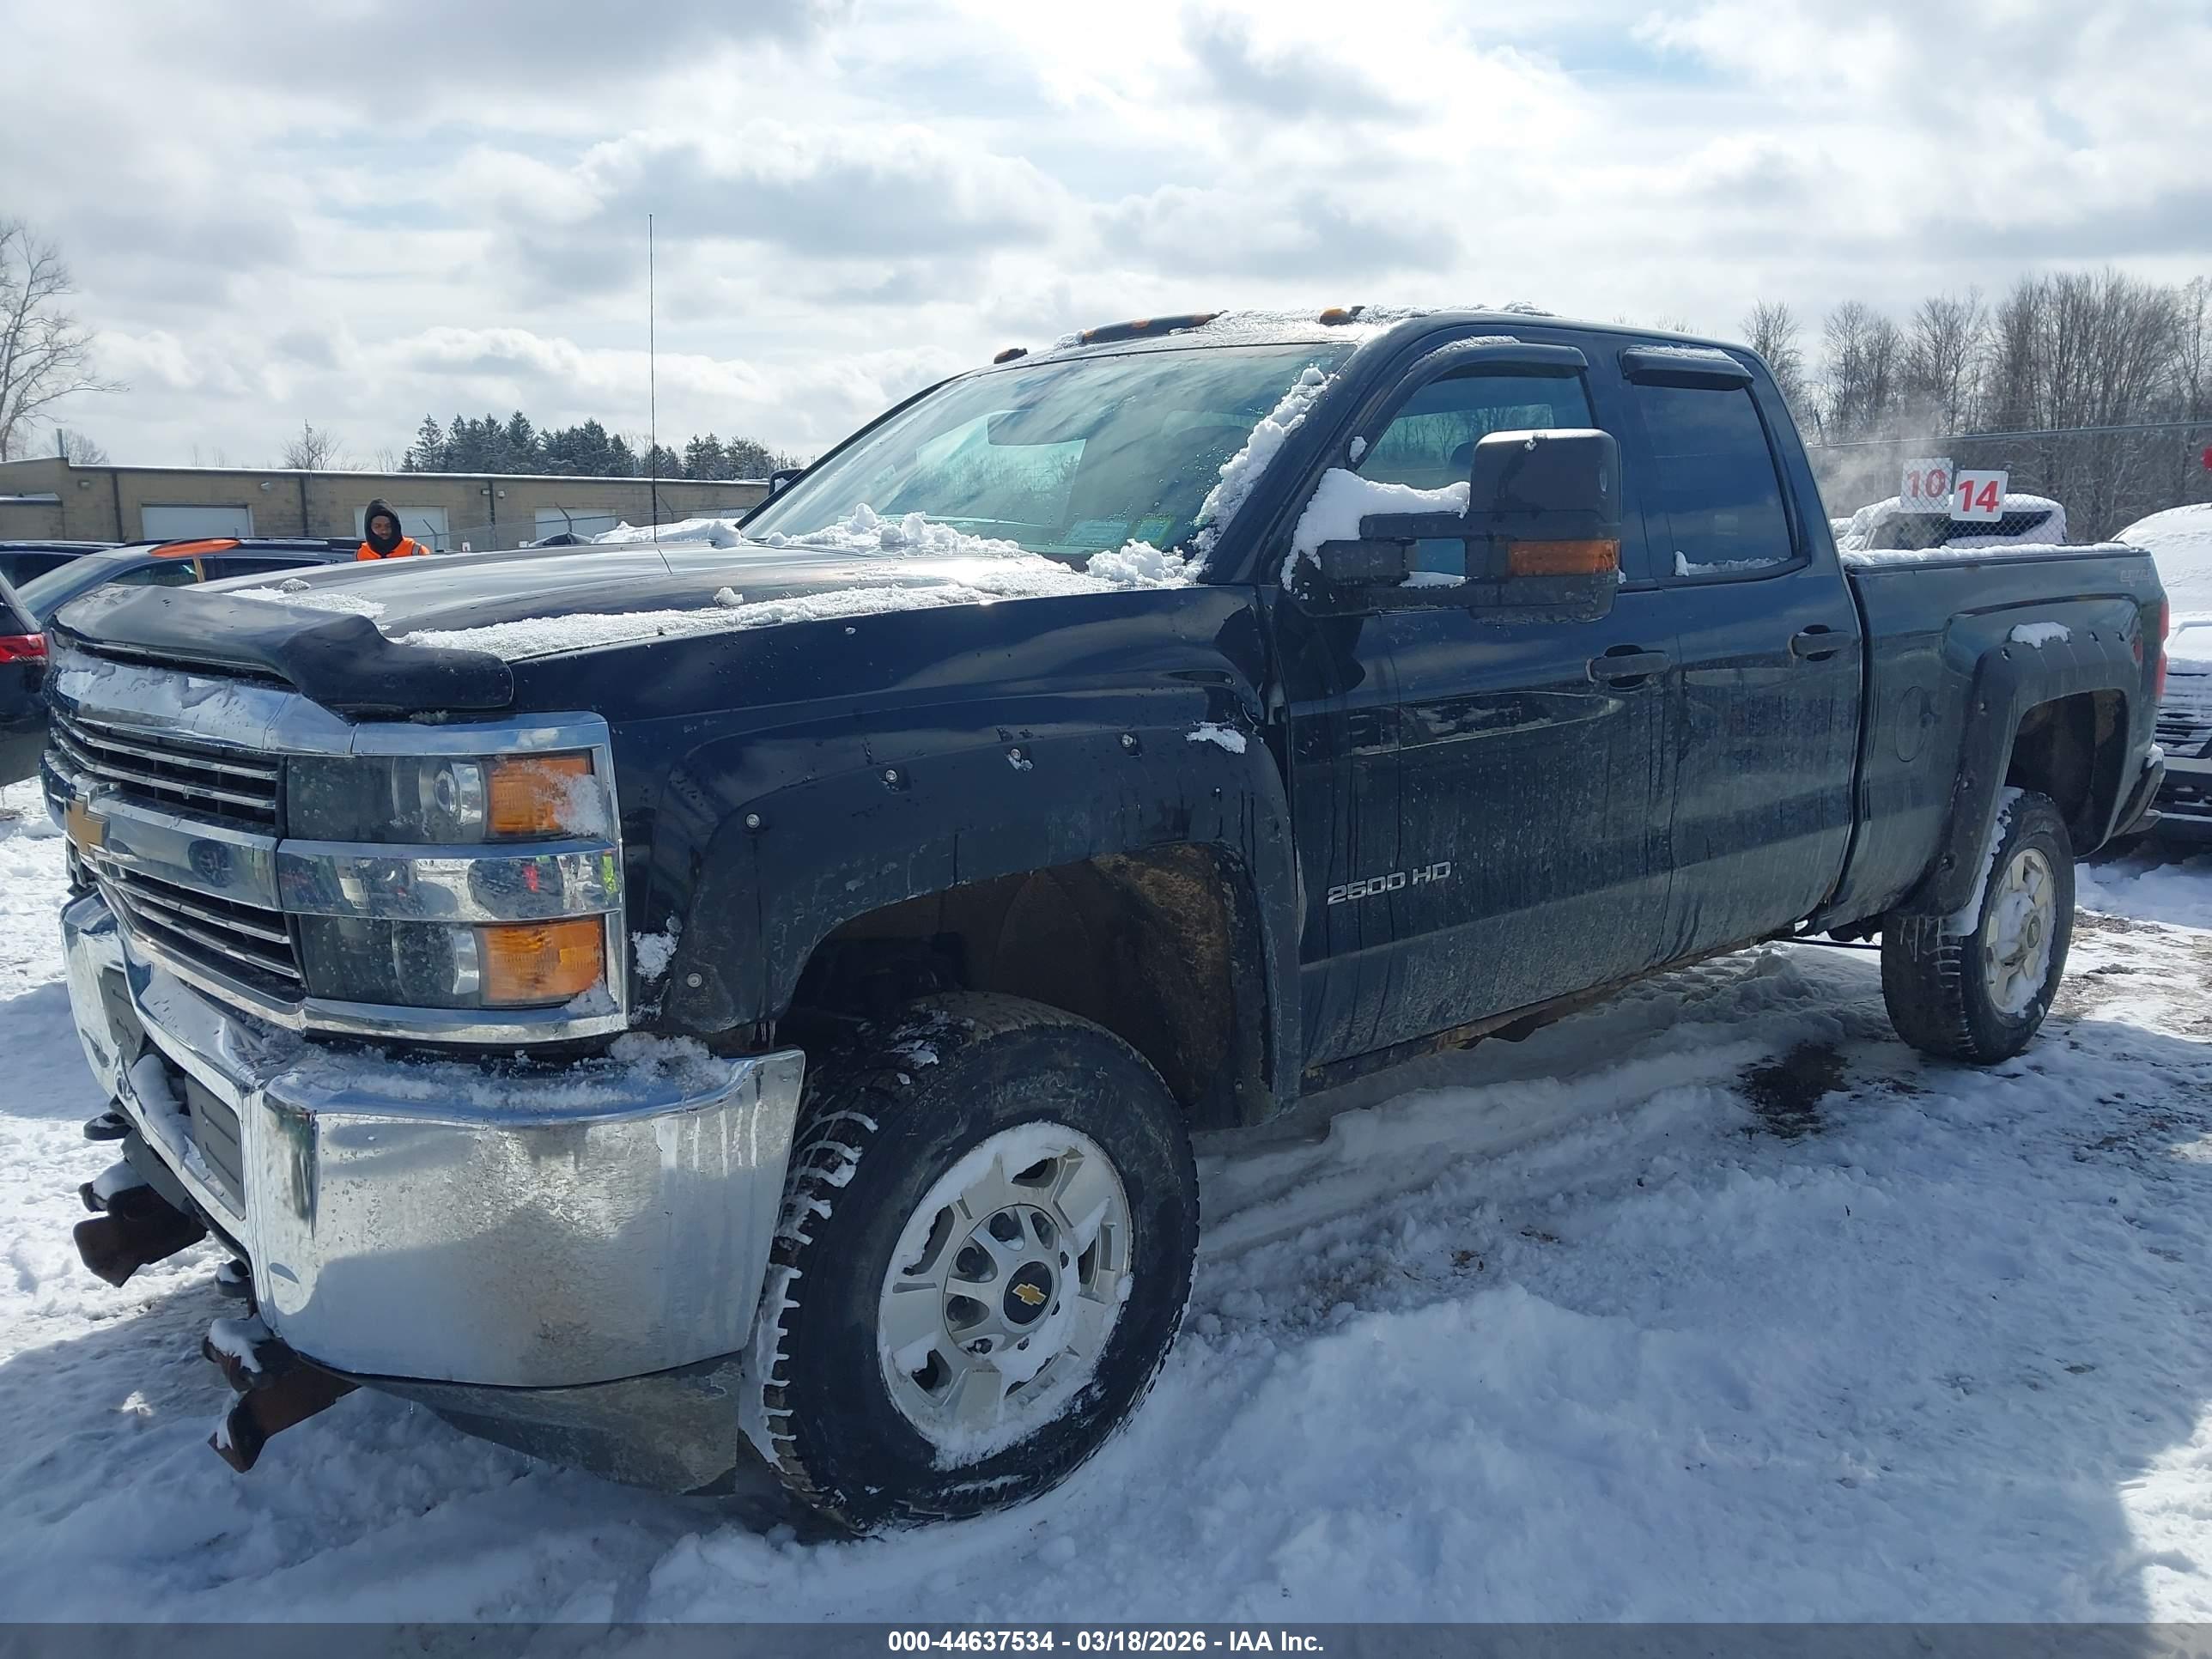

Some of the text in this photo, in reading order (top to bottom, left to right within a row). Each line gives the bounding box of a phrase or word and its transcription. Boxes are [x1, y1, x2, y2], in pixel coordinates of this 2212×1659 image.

[1907, 468, 1947, 499] 10
[1958, 479, 2001, 513] 14
[1327, 861, 1451, 906] 2500 HD
